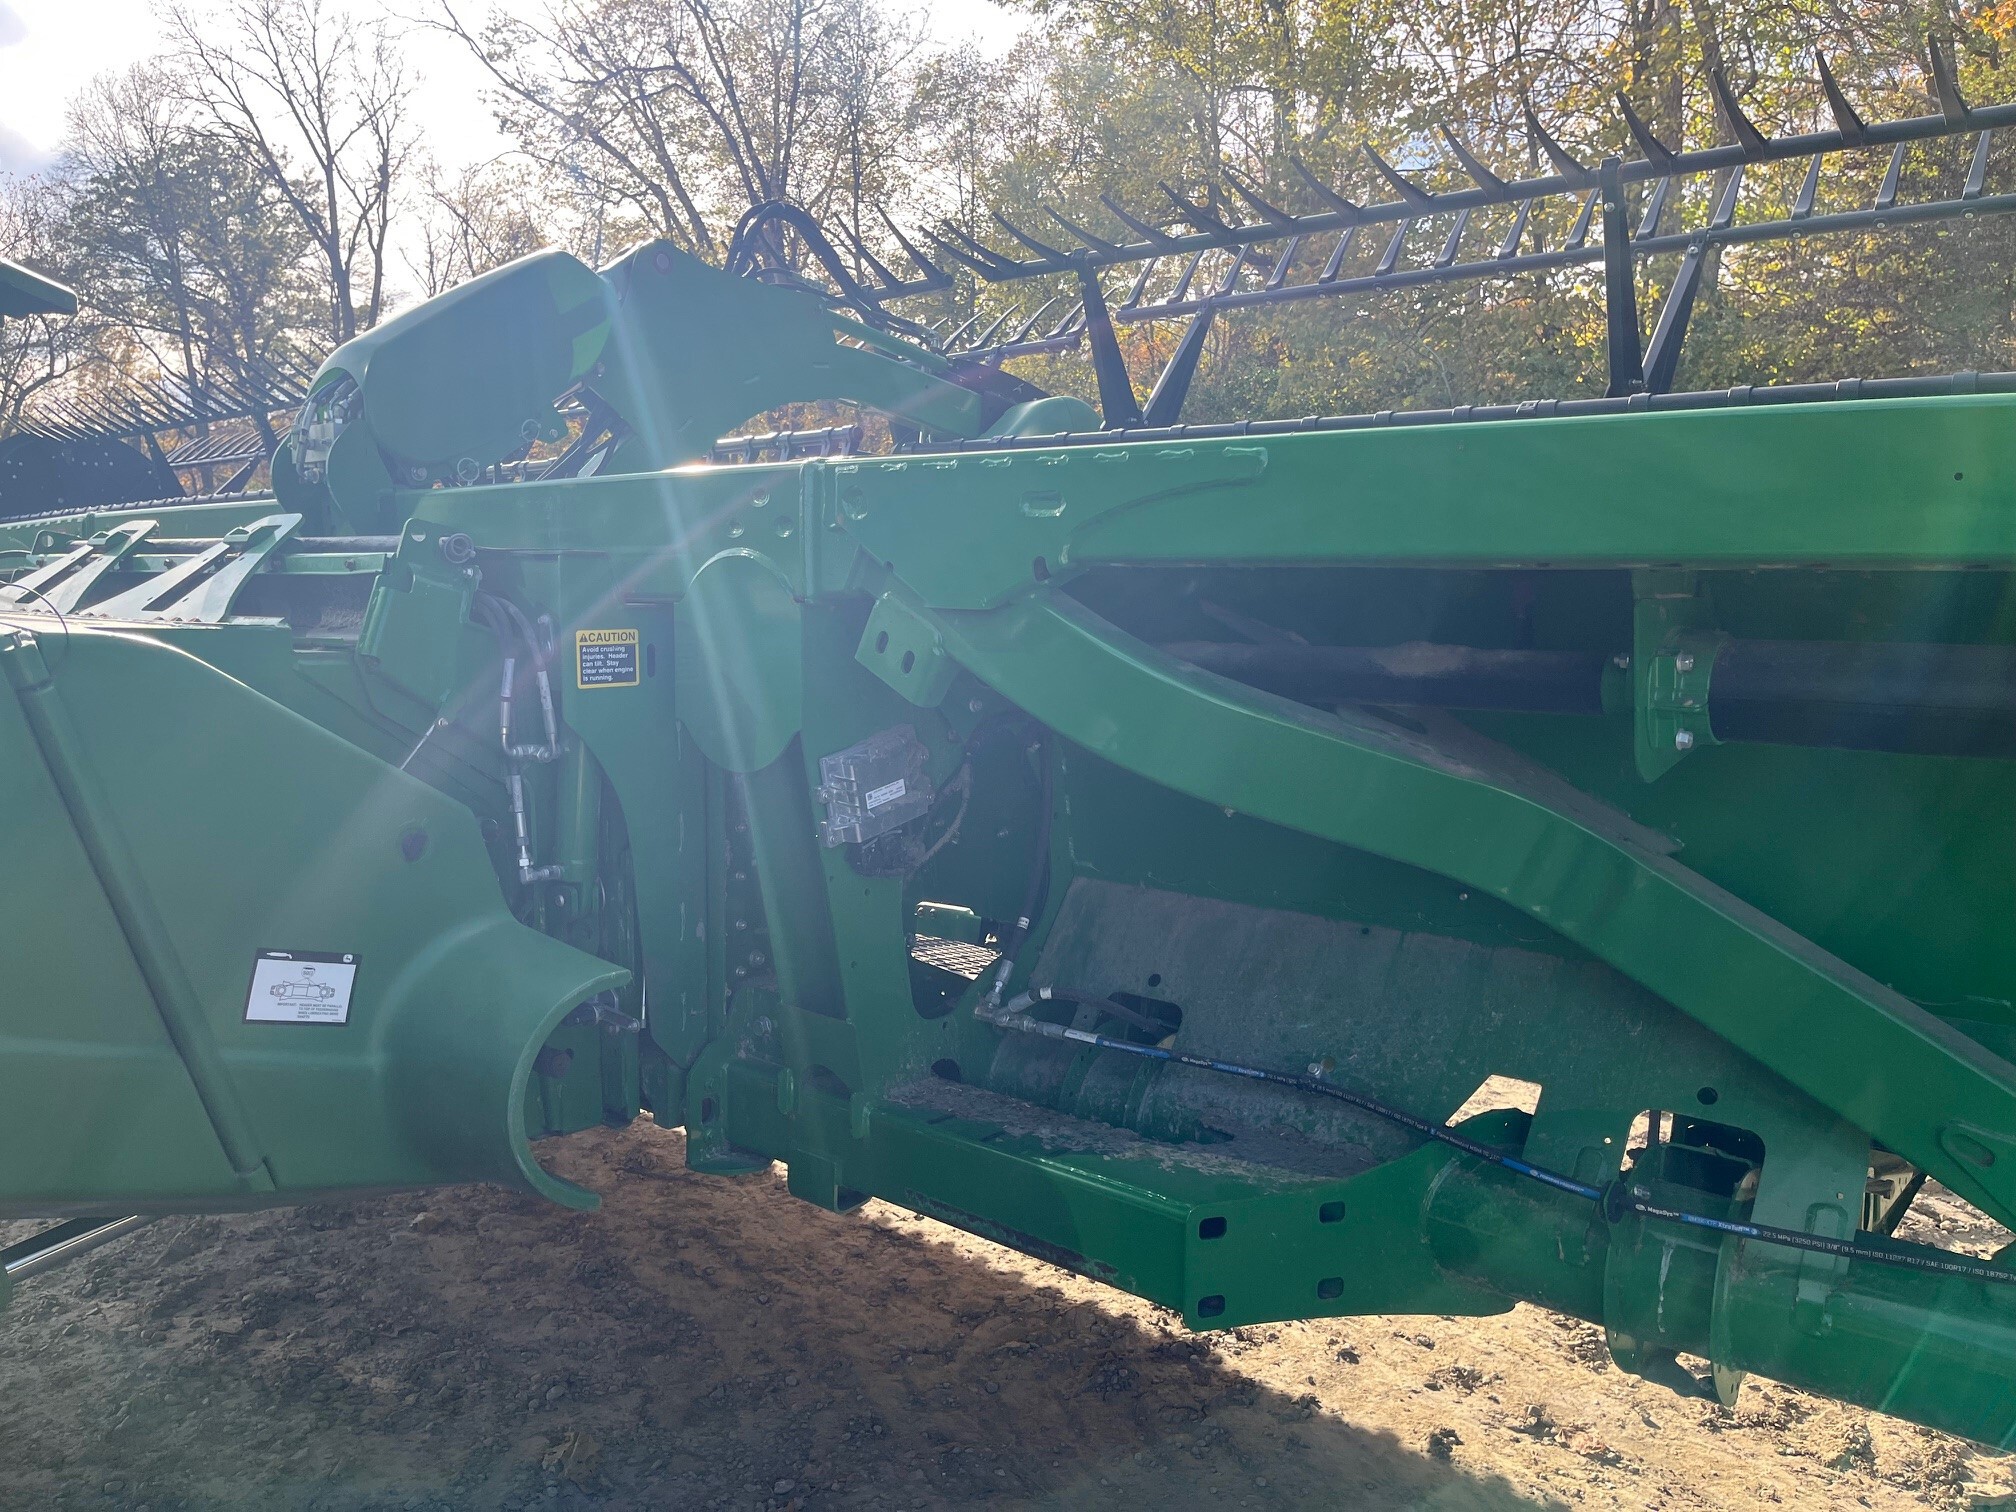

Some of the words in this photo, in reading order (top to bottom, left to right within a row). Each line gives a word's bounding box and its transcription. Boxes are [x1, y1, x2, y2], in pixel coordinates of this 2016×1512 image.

[588, 631, 636, 643] CAUTION
[600, 645, 626, 653] crushing
[615, 666, 634, 674] engine
[1855, 1249, 1871, 1257] mm)
[1872, 1251, 1884, 1259] ISO
[1926, 1260, 1940, 1268] SAE
[1941, 1262, 1967, 1272] 100R17
[1972, 1267, 1984, 1276] ISO
[1986, 1270, 2009, 1279] 18752
